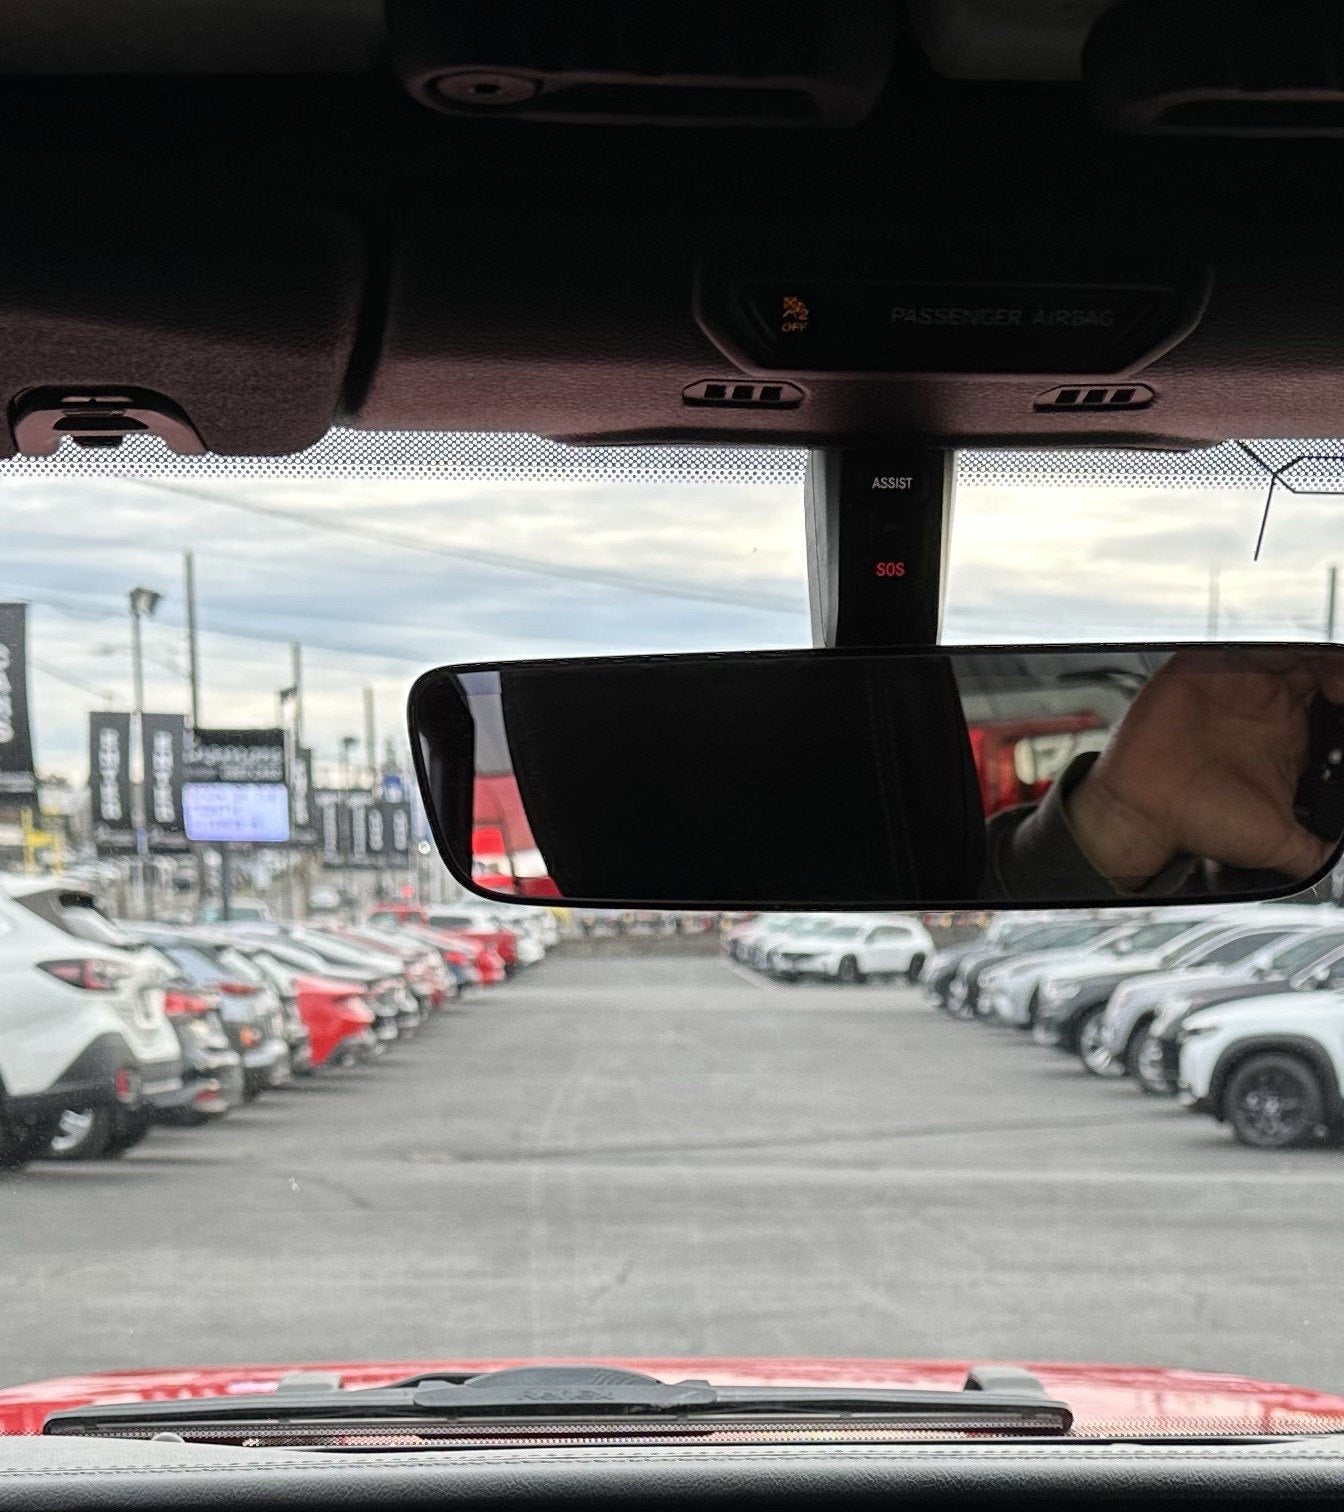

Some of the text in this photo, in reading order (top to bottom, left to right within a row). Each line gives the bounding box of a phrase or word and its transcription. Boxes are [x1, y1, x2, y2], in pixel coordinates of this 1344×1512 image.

[890, 307, 1114, 326] PASSENGER AIRBAG
[781, 322, 807, 332] OFF
[872, 477, 913, 489] ASSIST
[876, 562, 905, 576] SOS
